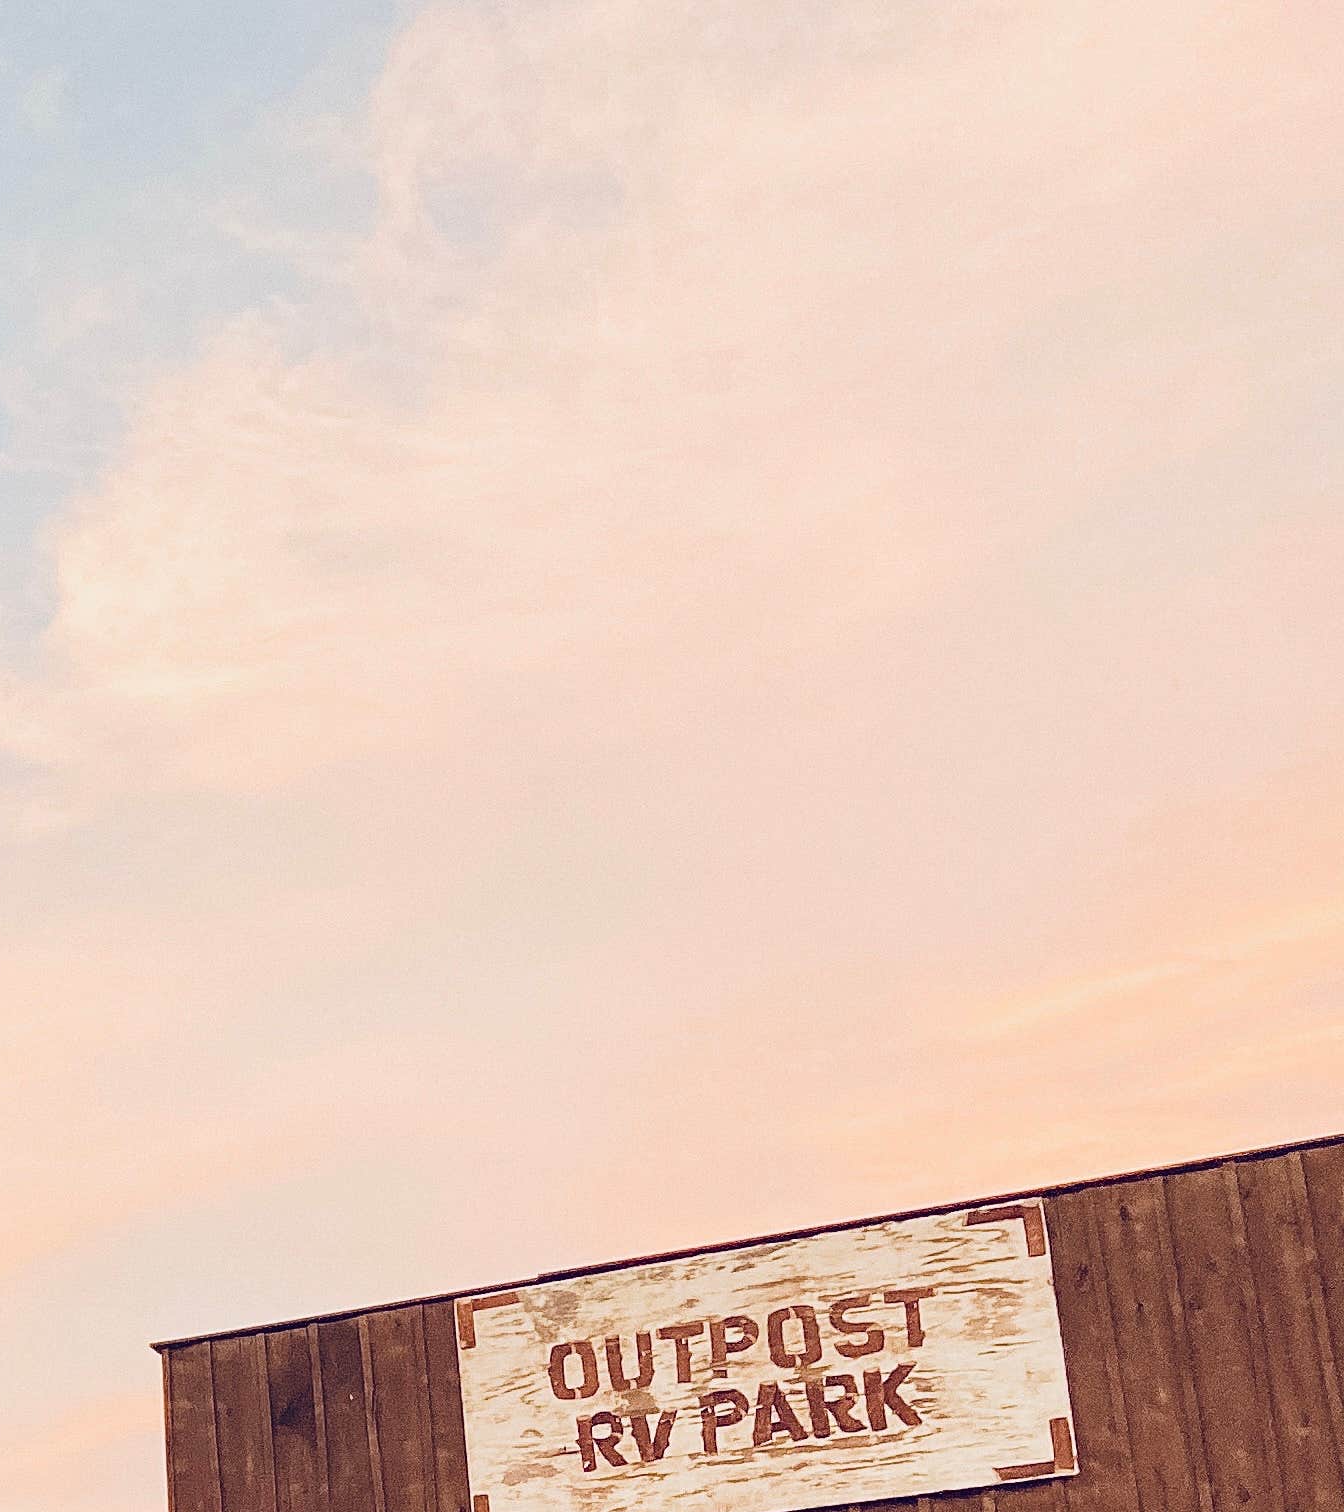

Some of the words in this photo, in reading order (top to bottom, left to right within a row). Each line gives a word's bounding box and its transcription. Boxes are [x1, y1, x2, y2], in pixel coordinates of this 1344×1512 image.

[548, 1287, 934, 1400] OUTPOST
[576, 1409, 677, 1473] RV
[699, 1364, 923, 1454] PARK
